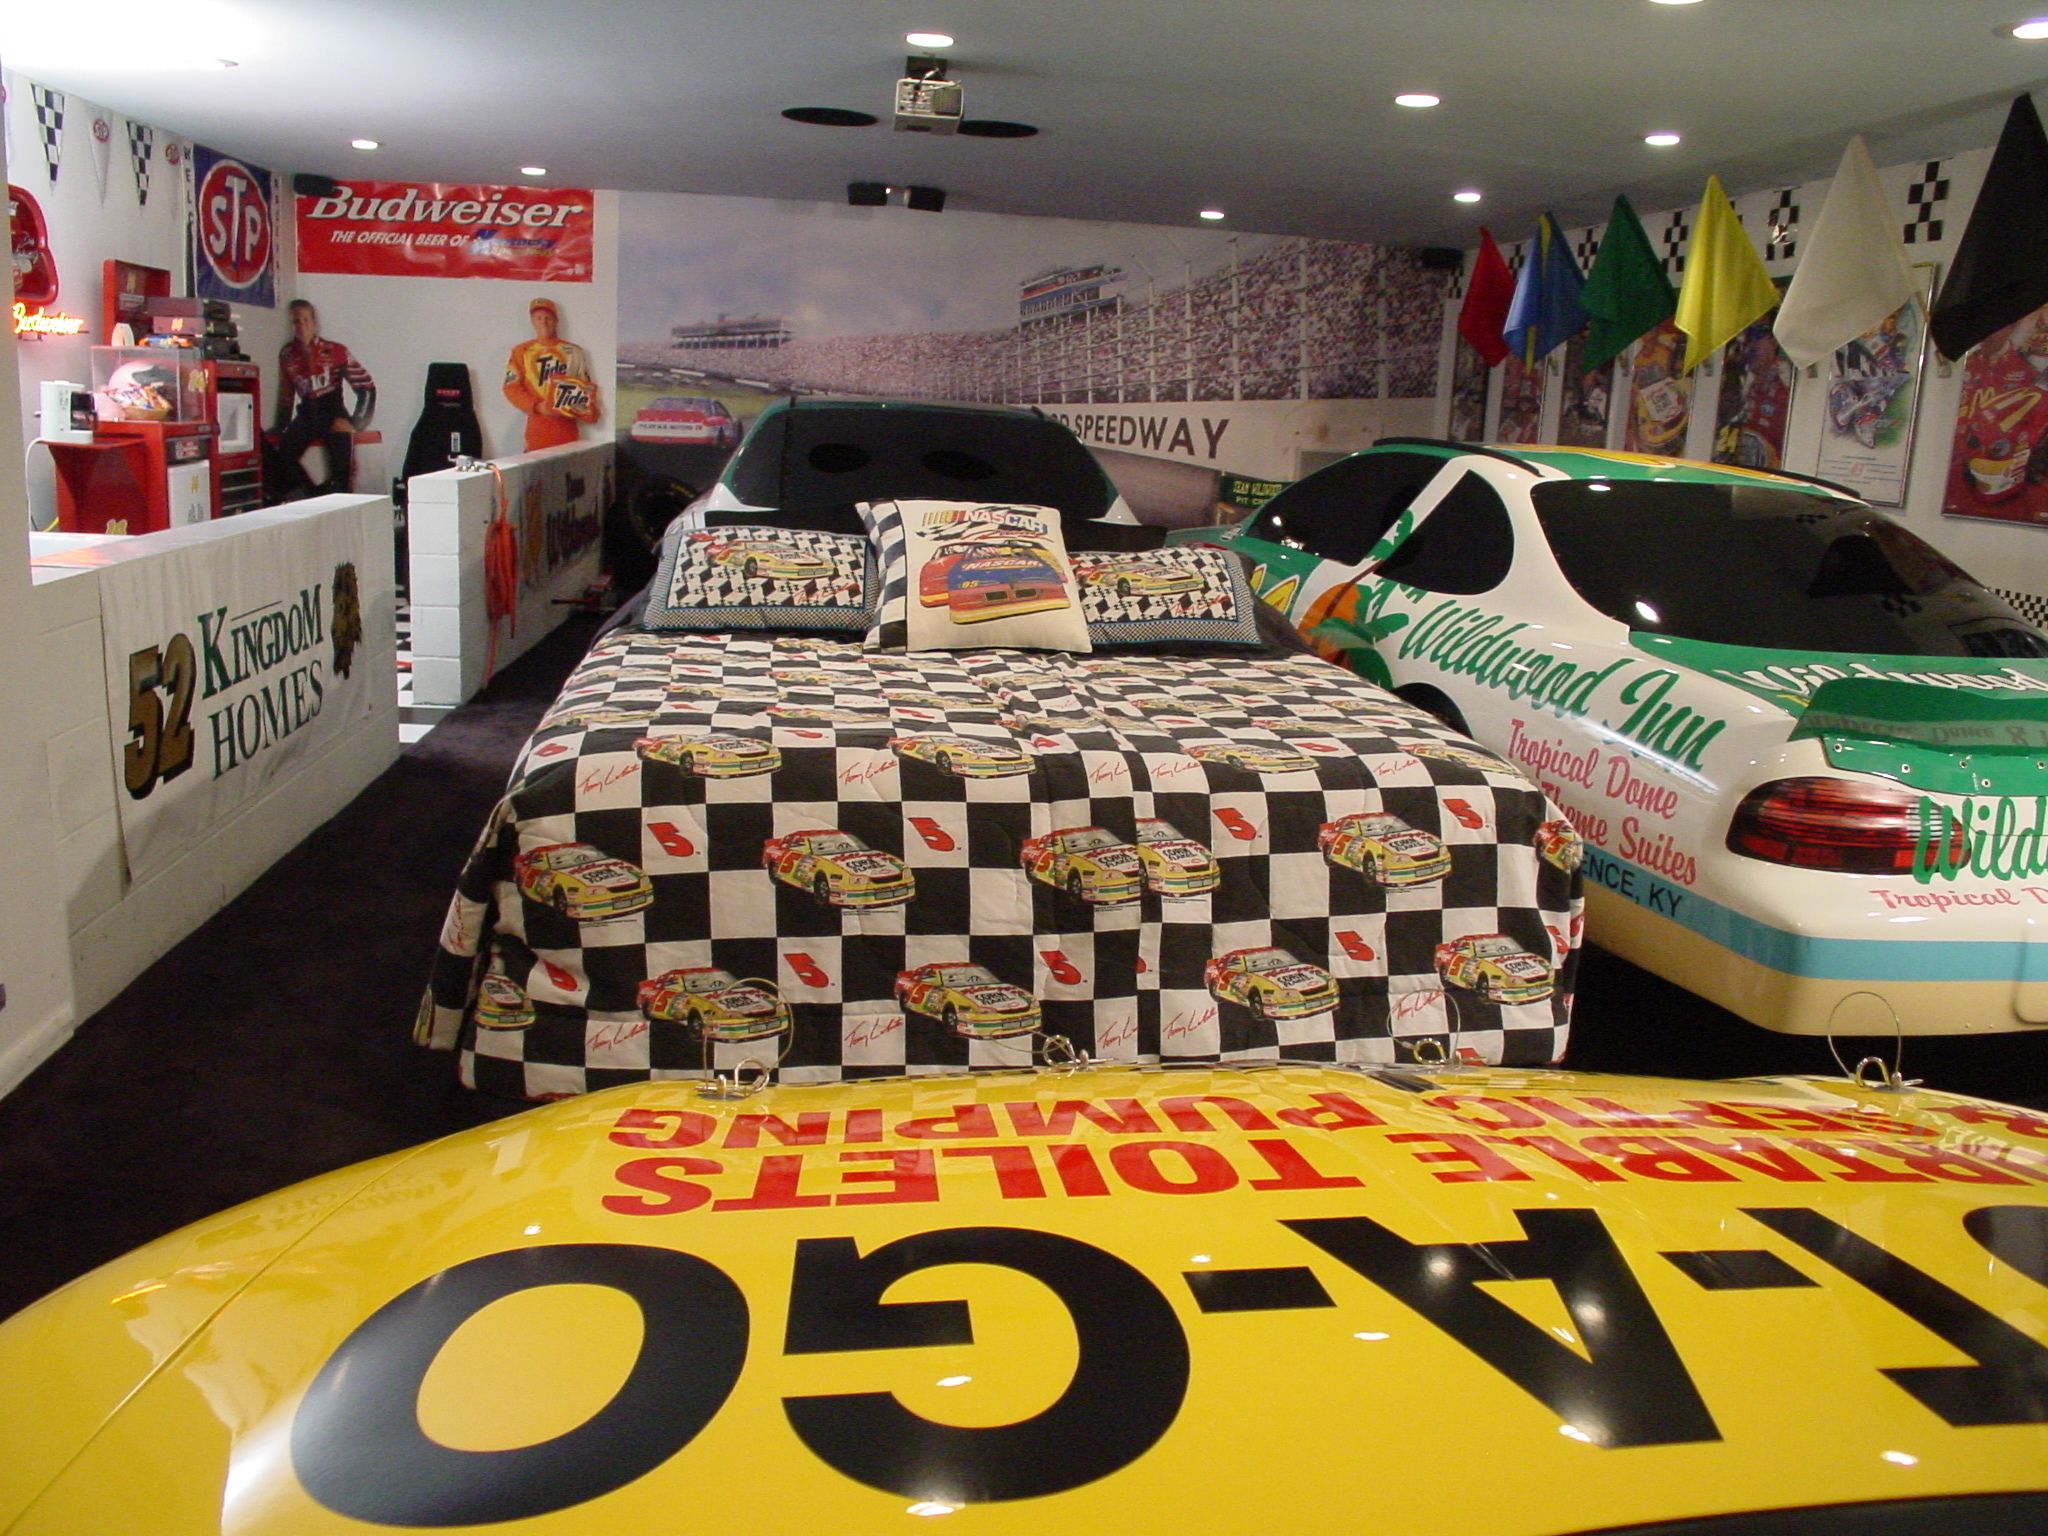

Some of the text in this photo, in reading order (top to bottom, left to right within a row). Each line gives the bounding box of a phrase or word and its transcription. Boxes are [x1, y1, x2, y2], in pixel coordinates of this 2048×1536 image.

[208, 173, 263, 267] STP
[307, 185, 584, 228] Budweiser
[330, 230, 353, 243] THE
[357, 231, 412, 245] OFFICIAL
[415, 232, 448, 246] BEER
[449, 234, 472, 247] OF
[536, 355, 568, 387] Tide
[554, 384, 590, 409] Tide
[1074, 413, 1230, 459] SPEEDWAY
[964, 510, 1047, 534] NASCAR
[1397, 600, 1635, 718] Wildwood
[123, 633, 198, 801] 52
[208, 659, 323, 781] HOMES
[1508, 718, 1679, 819] Tropical Dome
[1212, 807, 1257, 841] 5
[1442, 798, 1484, 829] 5
[647, 821, 695, 858] 5
[907, 817, 955, 852] 5
[1618, 816, 1697, 886] Suites
[1649, 882, 1683, 918] KY
[1869, 888, 2022, 913] Tropical
[1335, 930, 1376, 962] 5
[783, 952, 830, 989] 5
[1039, 950, 1082, 986] 5
[607, 1091, 1389, 1150] PUMPING
[601, 1138, 1367, 1217] TOILETS
